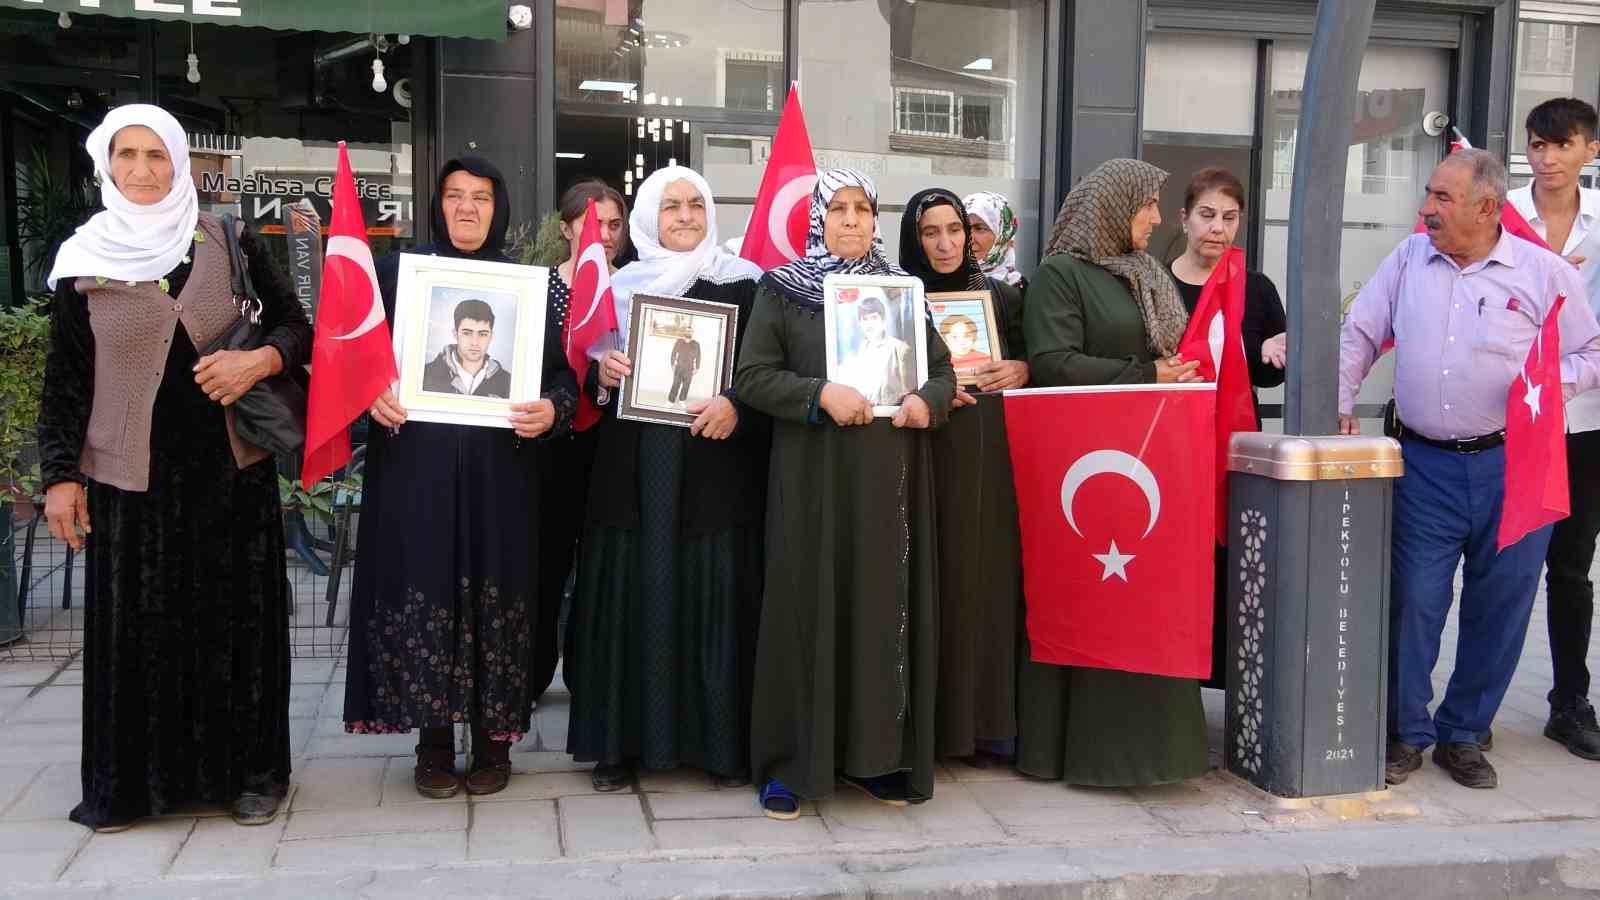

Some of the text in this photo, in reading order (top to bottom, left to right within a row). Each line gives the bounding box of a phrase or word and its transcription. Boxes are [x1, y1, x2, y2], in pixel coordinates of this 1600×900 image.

[201, 172, 393, 199] Maâhsa Cfee
[1325, 749, 1354, 761] 2021
